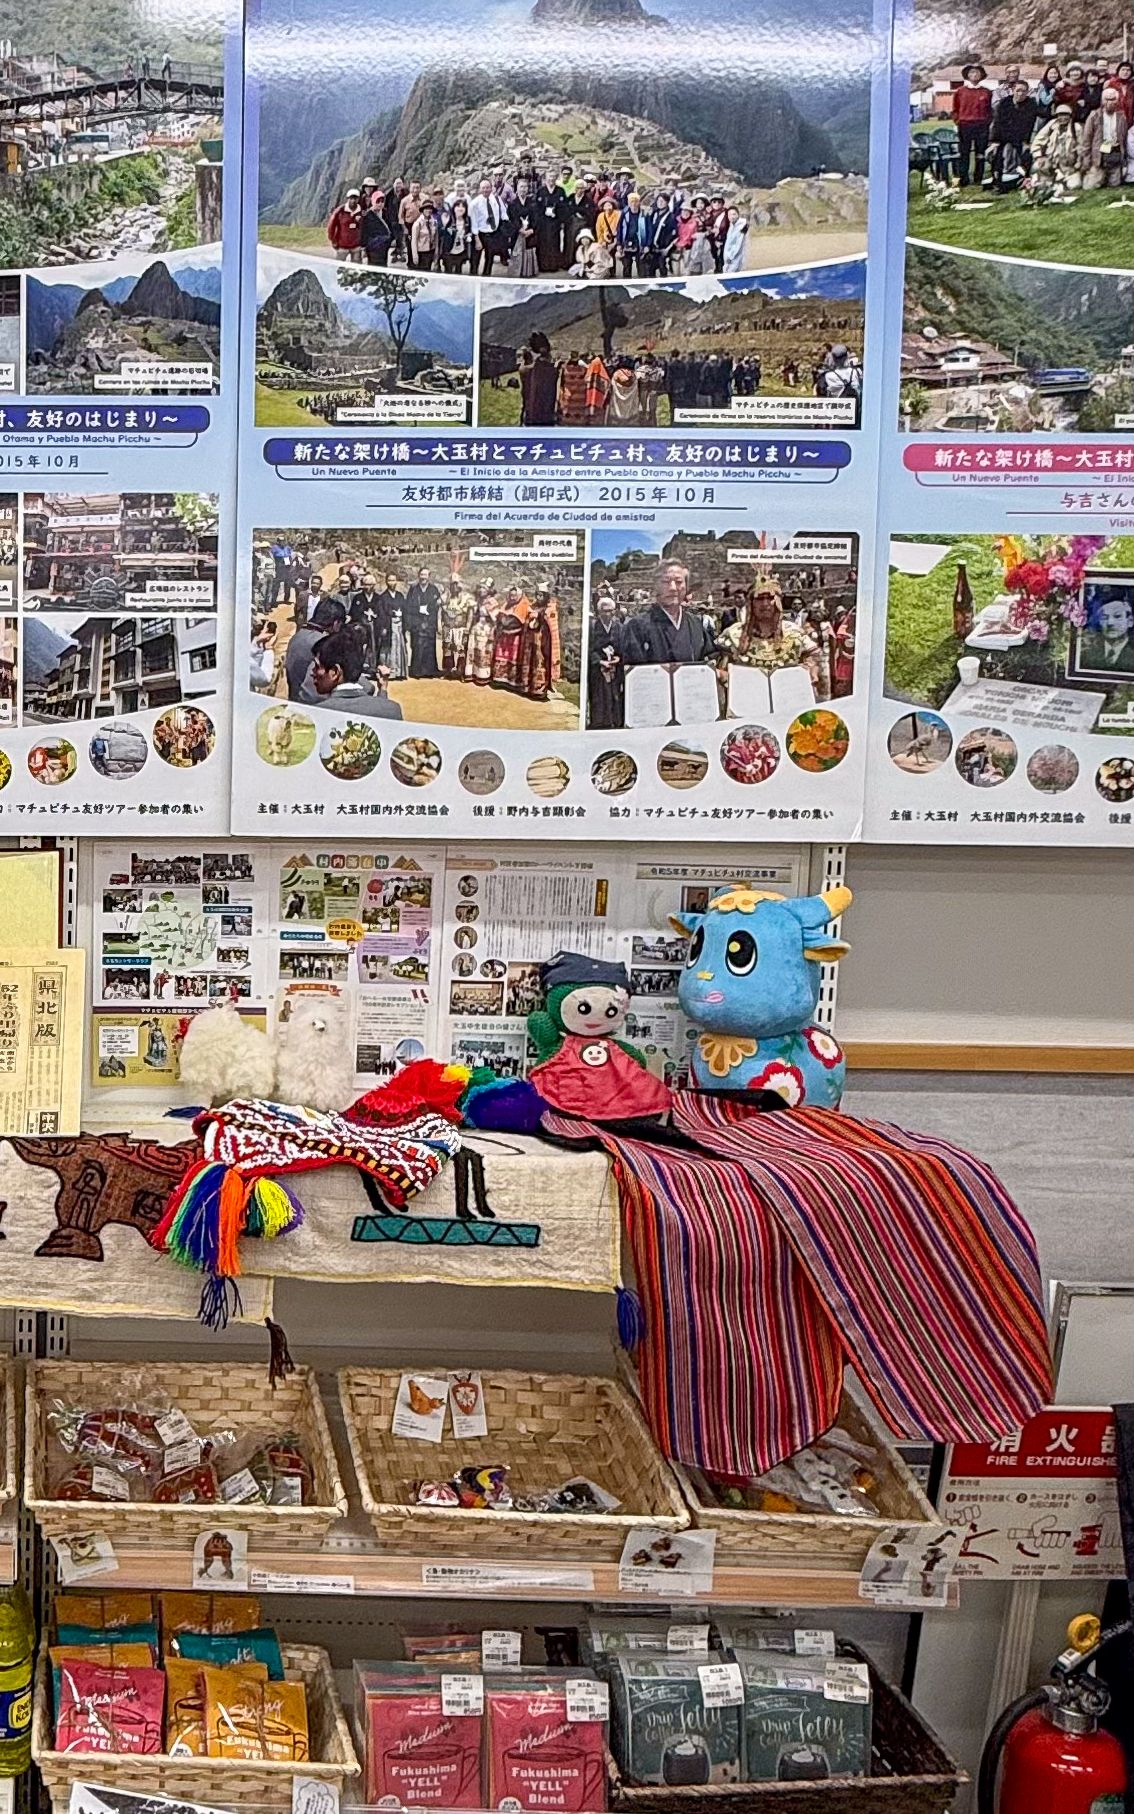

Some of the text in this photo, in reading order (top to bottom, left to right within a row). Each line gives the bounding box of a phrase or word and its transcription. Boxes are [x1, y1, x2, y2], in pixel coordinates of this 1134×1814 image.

[3, 435, 35, 443] Otama
[47, 435, 80, 443] Pueblo
[83, 435, 115, 443] Machu
[118, 435, 151, 443] Picchu
[312, 467, 325, 476] Un
[328, 467, 359, 476] Nuevo
[362, 467, 397, 476] Puente
[473, 467, 500, 476] Inicio
[531, 468, 572, 477] Amistad
[604, 469, 638, 477] Pueblo
[641, 469, 674, 478] Otama
[685, 470, 719, 478] Pueblo
[722, 470, 755, 478] Machu
[758, 470, 791, 478] Picchu
[952, 474, 1039, 482] Un Nuevo Puente
[401, 486, 580, 502] 友好都市締結（調印式）
[454, 512, 656, 522] Firma del Acuerdo de Ciudad de amistad
[337, 804, 450, 816] 大玉村国内外交流協会
[970, 811, 1086, 824] 大玉村国内外交流協会
[35, 979, 57, 1038] 県北版
[986, 1456, 1117, 1467] FIRE EXTINGUISHE
[392, 1764, 457, 1776] Fukushima
[512, 1767, 579, 1777] Fukushima
[407, 1788, 442, 1799] Blend
[528, 1793, 565, 1804] Blend
